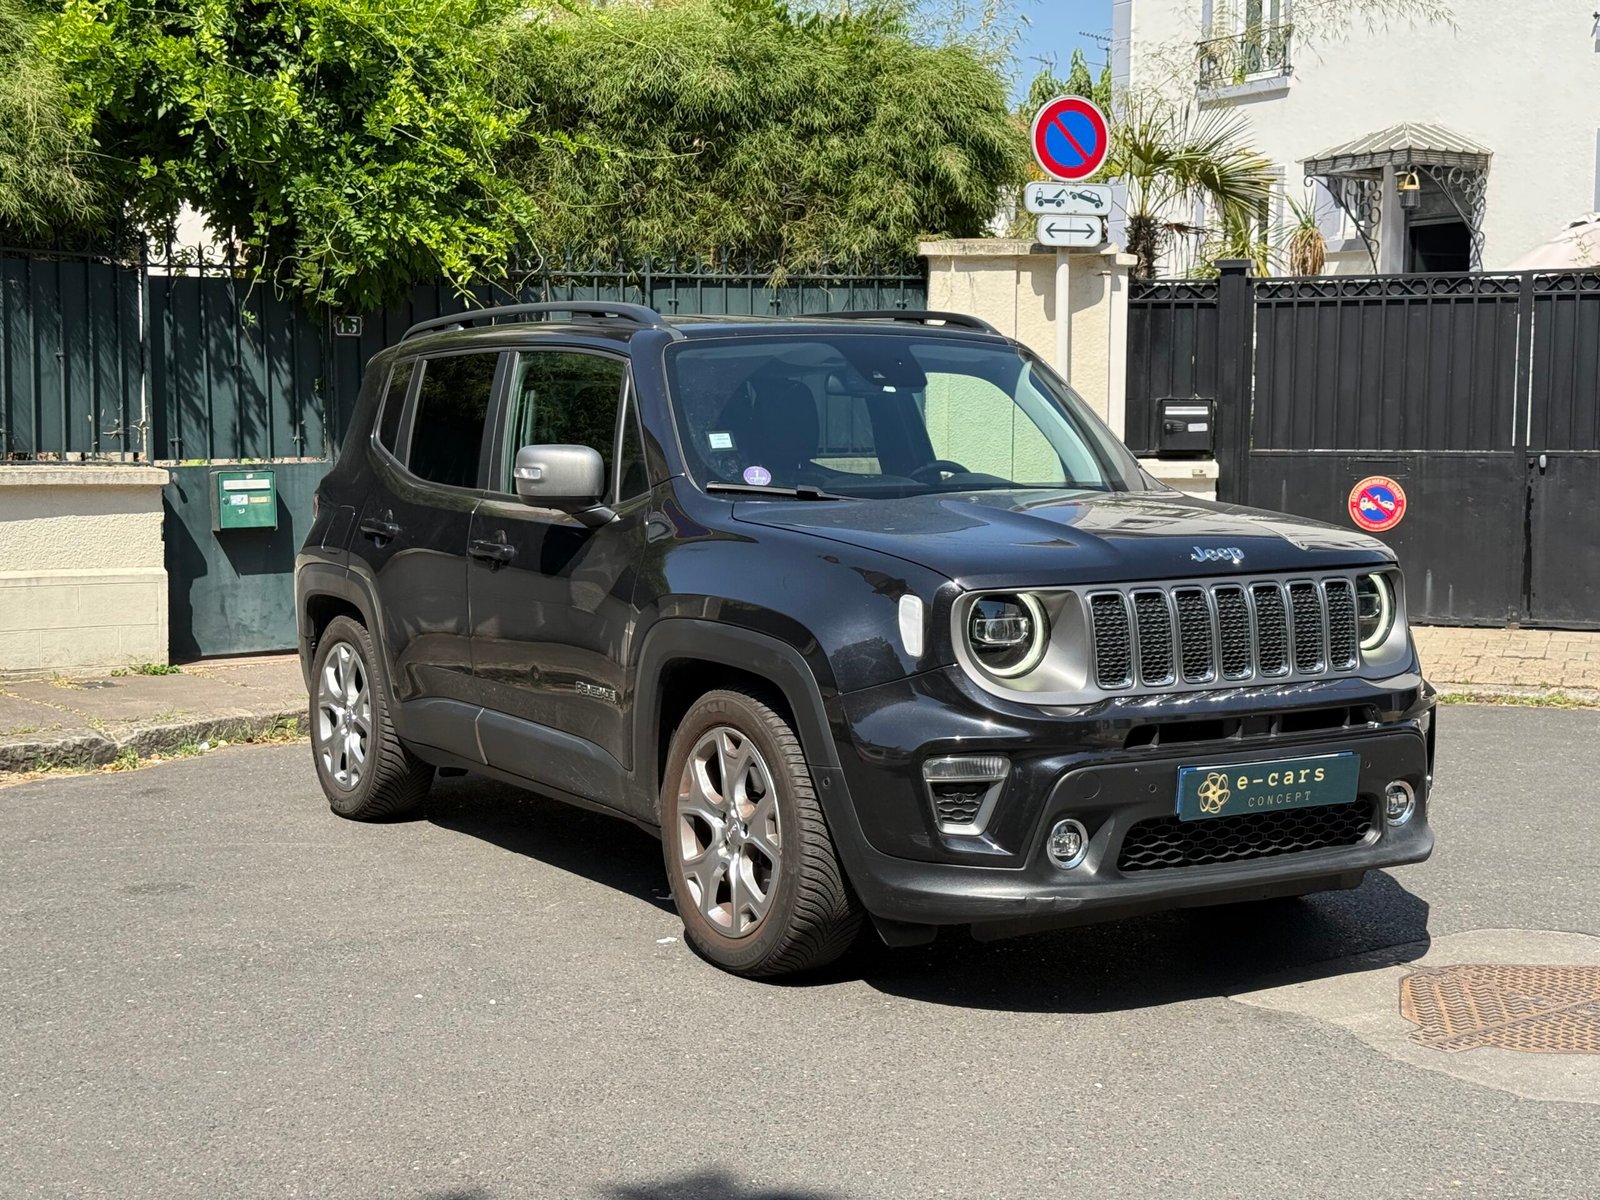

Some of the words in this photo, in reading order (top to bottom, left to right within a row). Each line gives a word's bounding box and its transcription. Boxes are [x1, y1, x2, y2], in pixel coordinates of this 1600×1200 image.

[1190, 546, 1245, 564] Jeep
[1236, 767, 1325, 790] e-cars
[1248, 790, 1312, 808] CONCEPT
